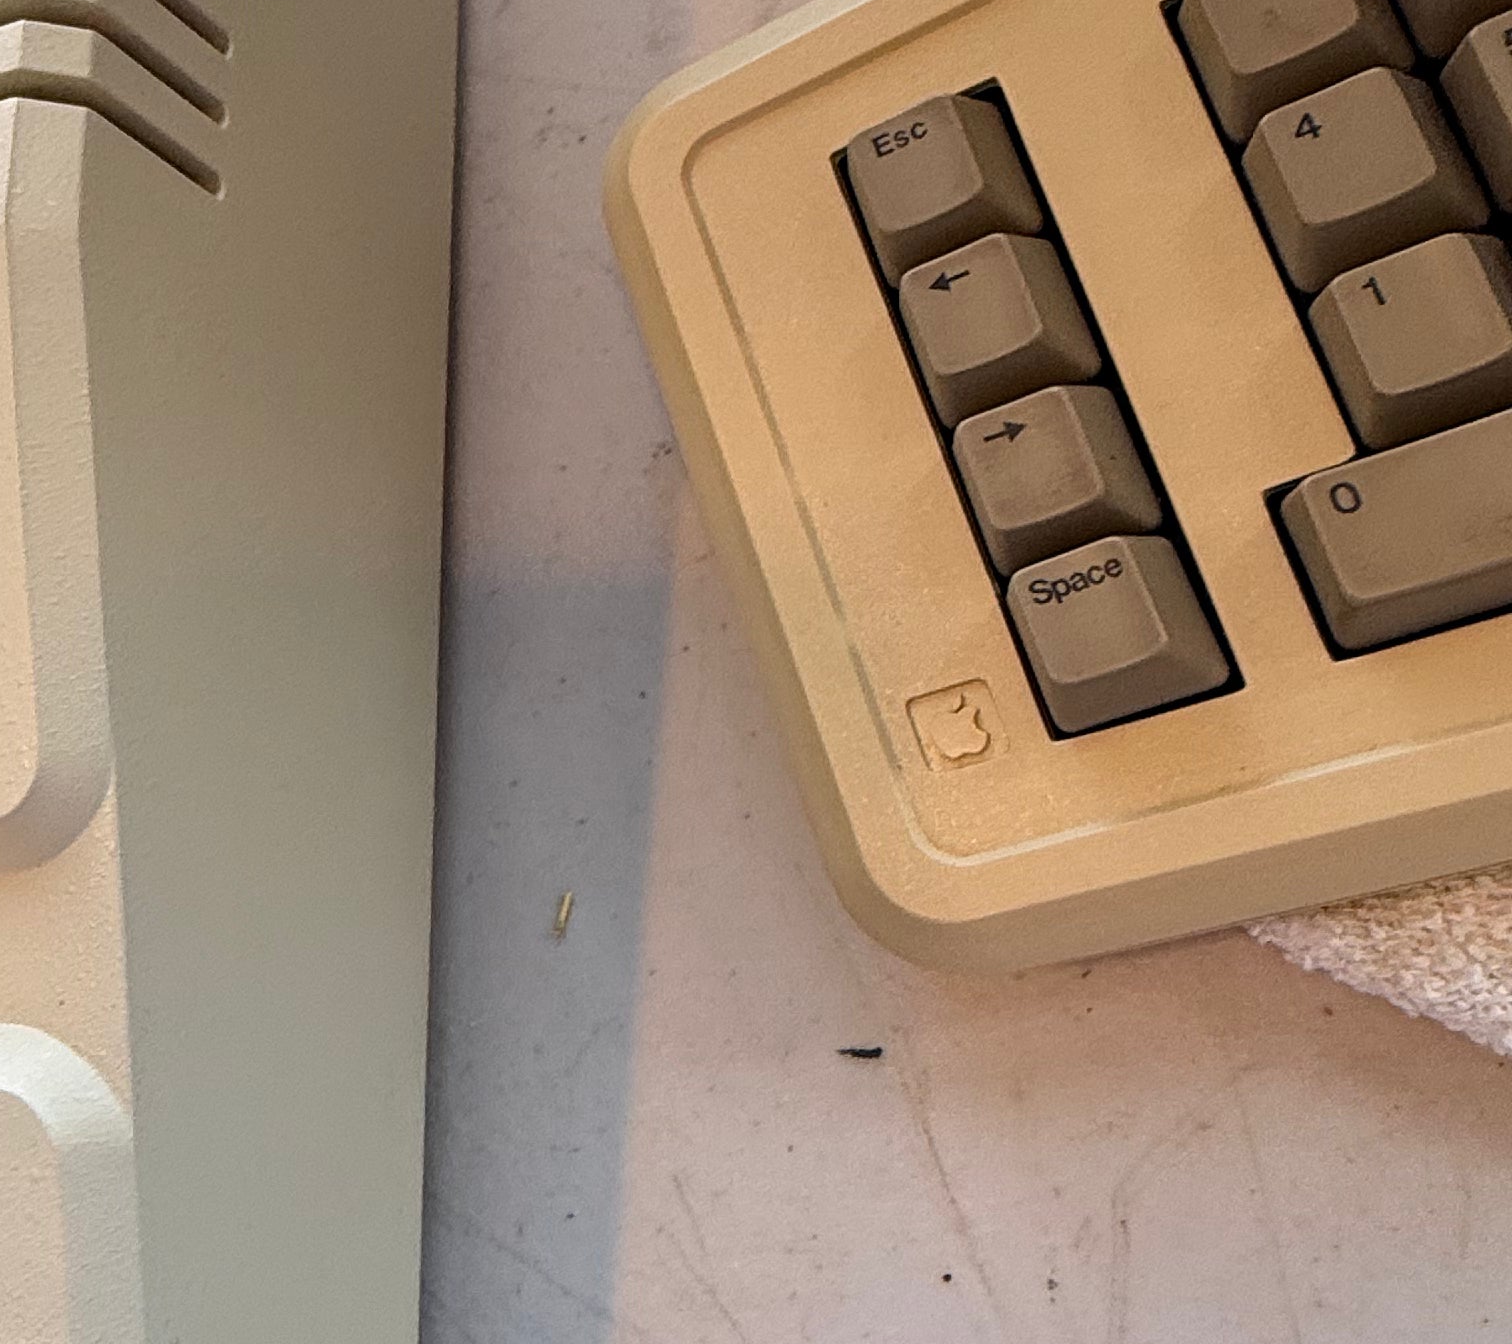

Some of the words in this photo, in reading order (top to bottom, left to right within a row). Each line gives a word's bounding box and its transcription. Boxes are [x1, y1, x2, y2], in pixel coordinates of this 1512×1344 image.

[872, 122, 928, 158] Esc
[1294, 112, 1322, 143] 4
[1361, 276, 1386, 306] 1
[1329, 481, 1363, 514] 0
[1029, 558, 1123, 604] Space
